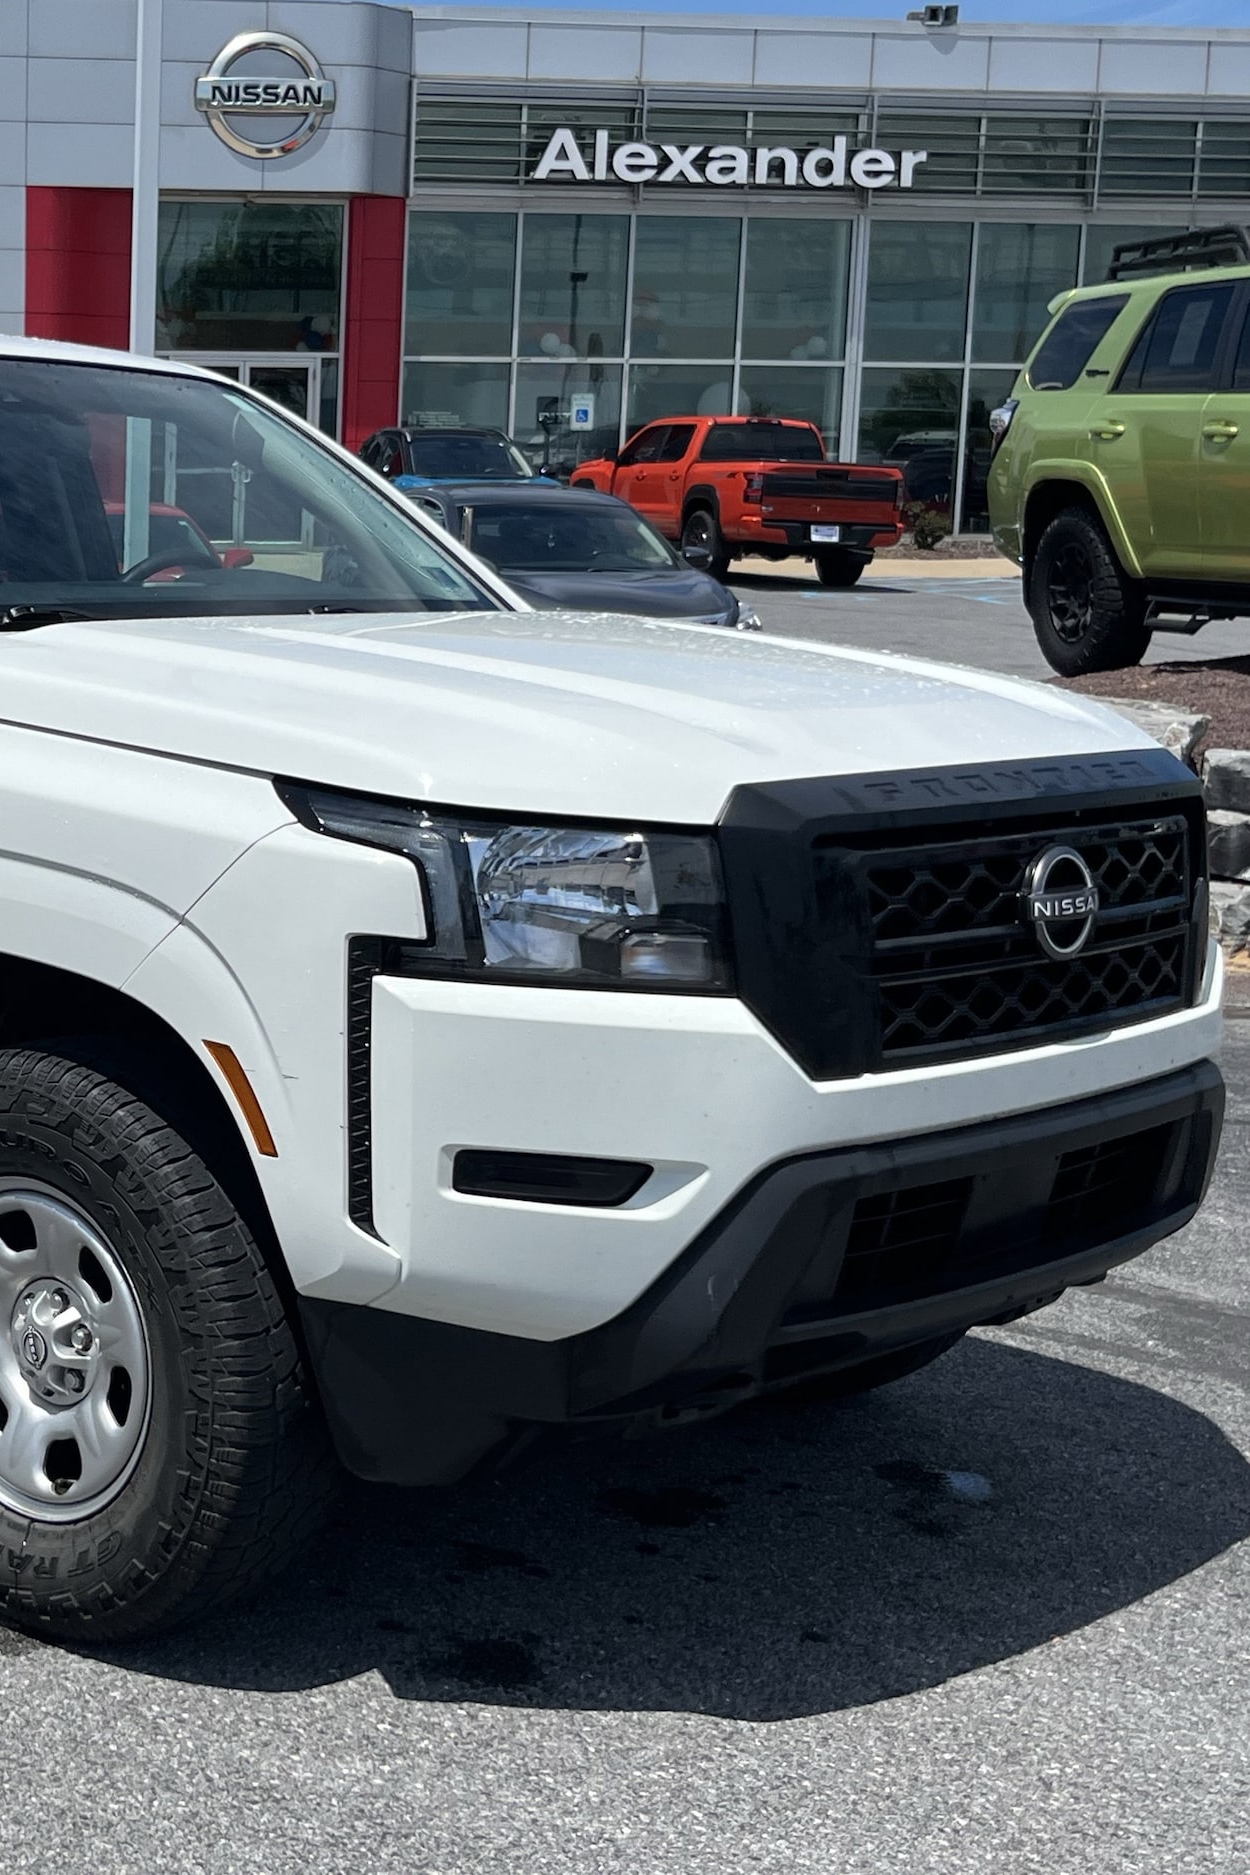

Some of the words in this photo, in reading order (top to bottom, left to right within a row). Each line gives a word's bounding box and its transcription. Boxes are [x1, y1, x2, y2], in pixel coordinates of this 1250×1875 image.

[210, 83, 324, 106] NISSAN
[532, 127, 928, 189] Alexander
[1033, 895, 1096, 918] NISSA
